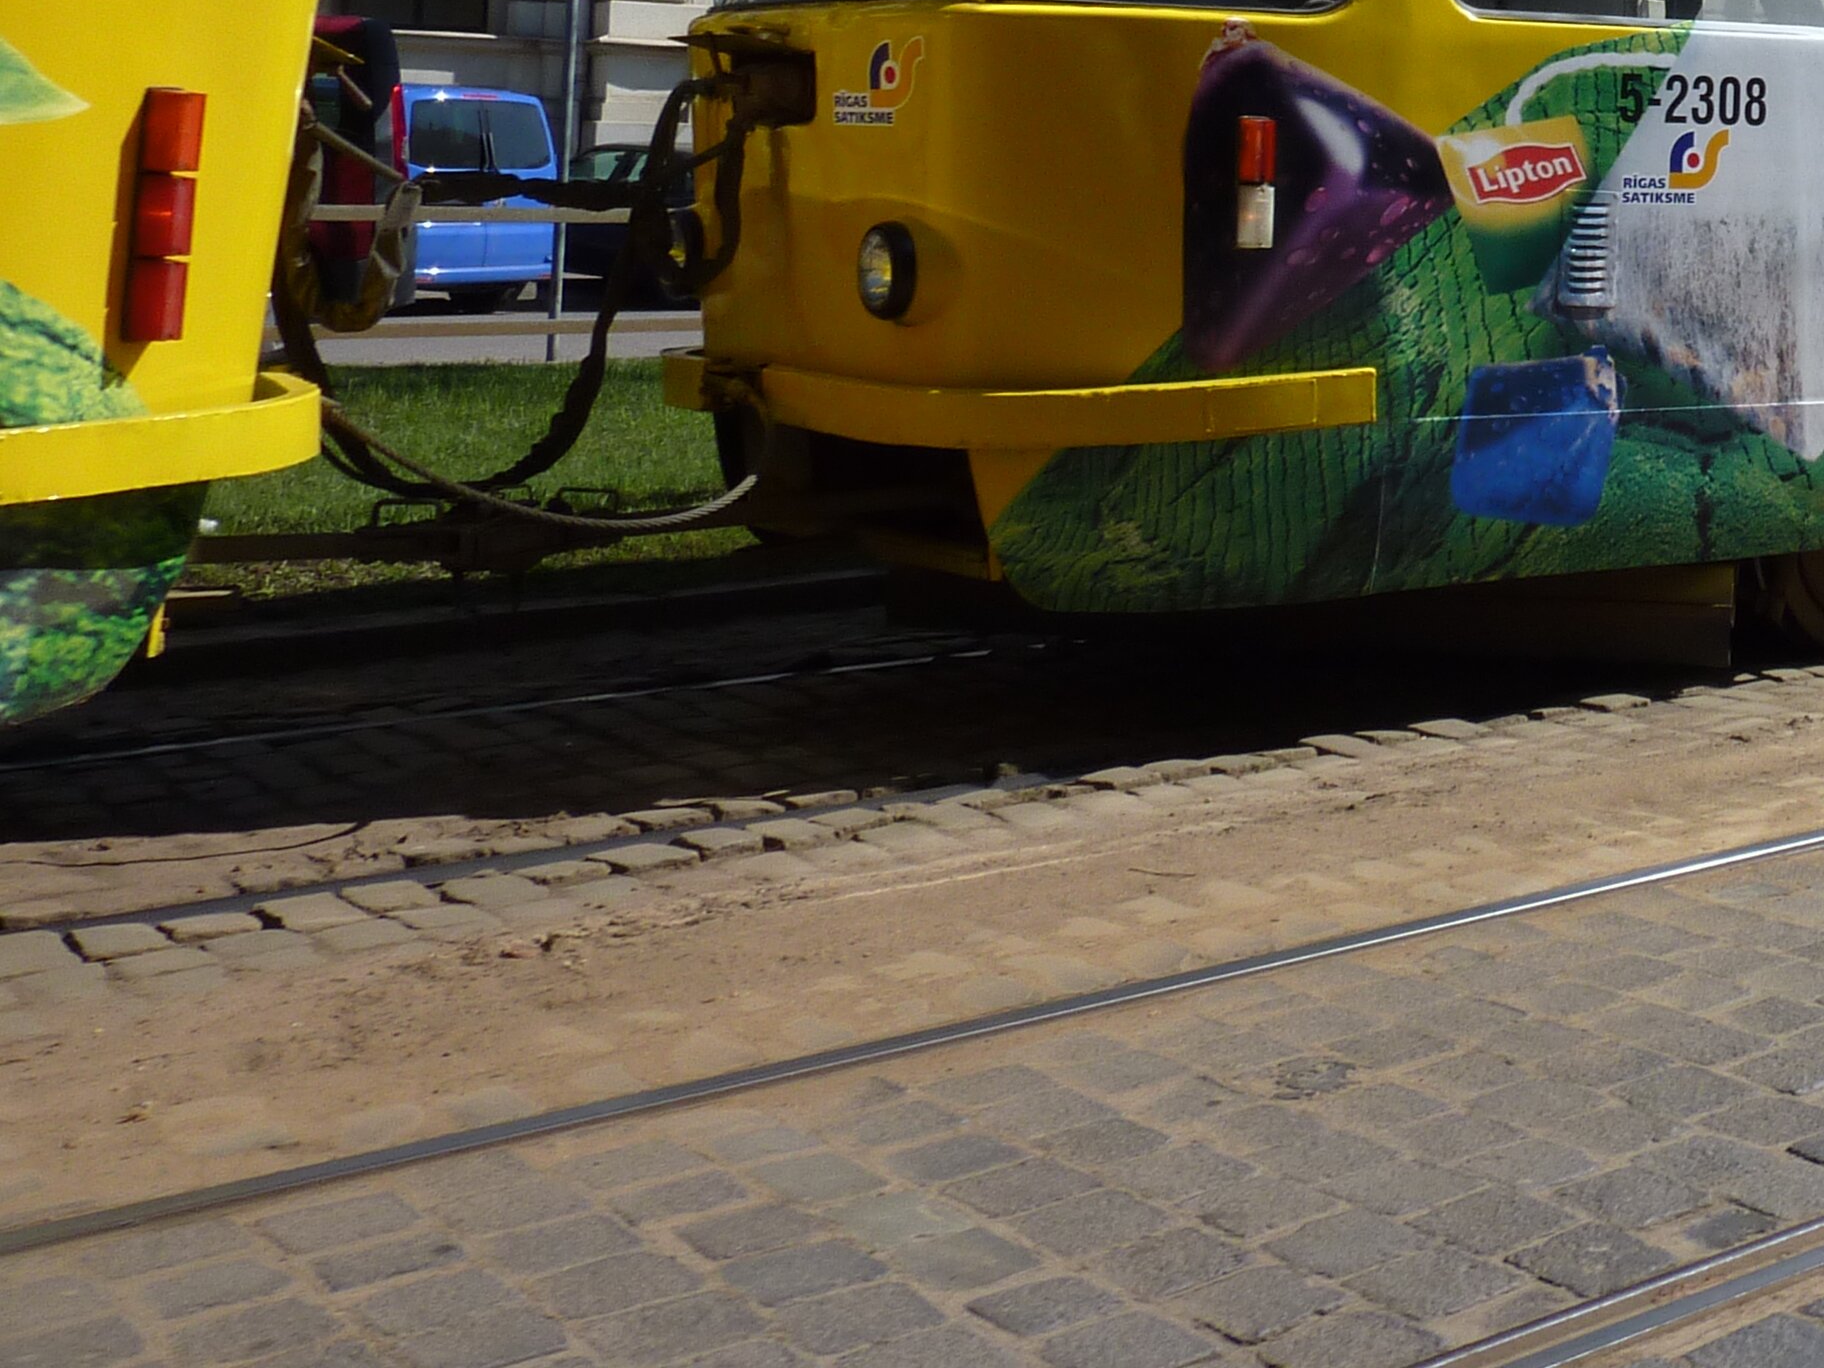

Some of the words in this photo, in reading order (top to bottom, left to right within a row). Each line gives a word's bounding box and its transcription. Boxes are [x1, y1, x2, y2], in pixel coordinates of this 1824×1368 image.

[1617, 73, 1767, 126] 5-2308
[834, 111, 894, 124] SATIKSME
[1478, 155, 1574, 192] Lipton
[1623, 174, 1667, 189] RĪGAS
[1621, 192, 1696, 204] SATIKSME
